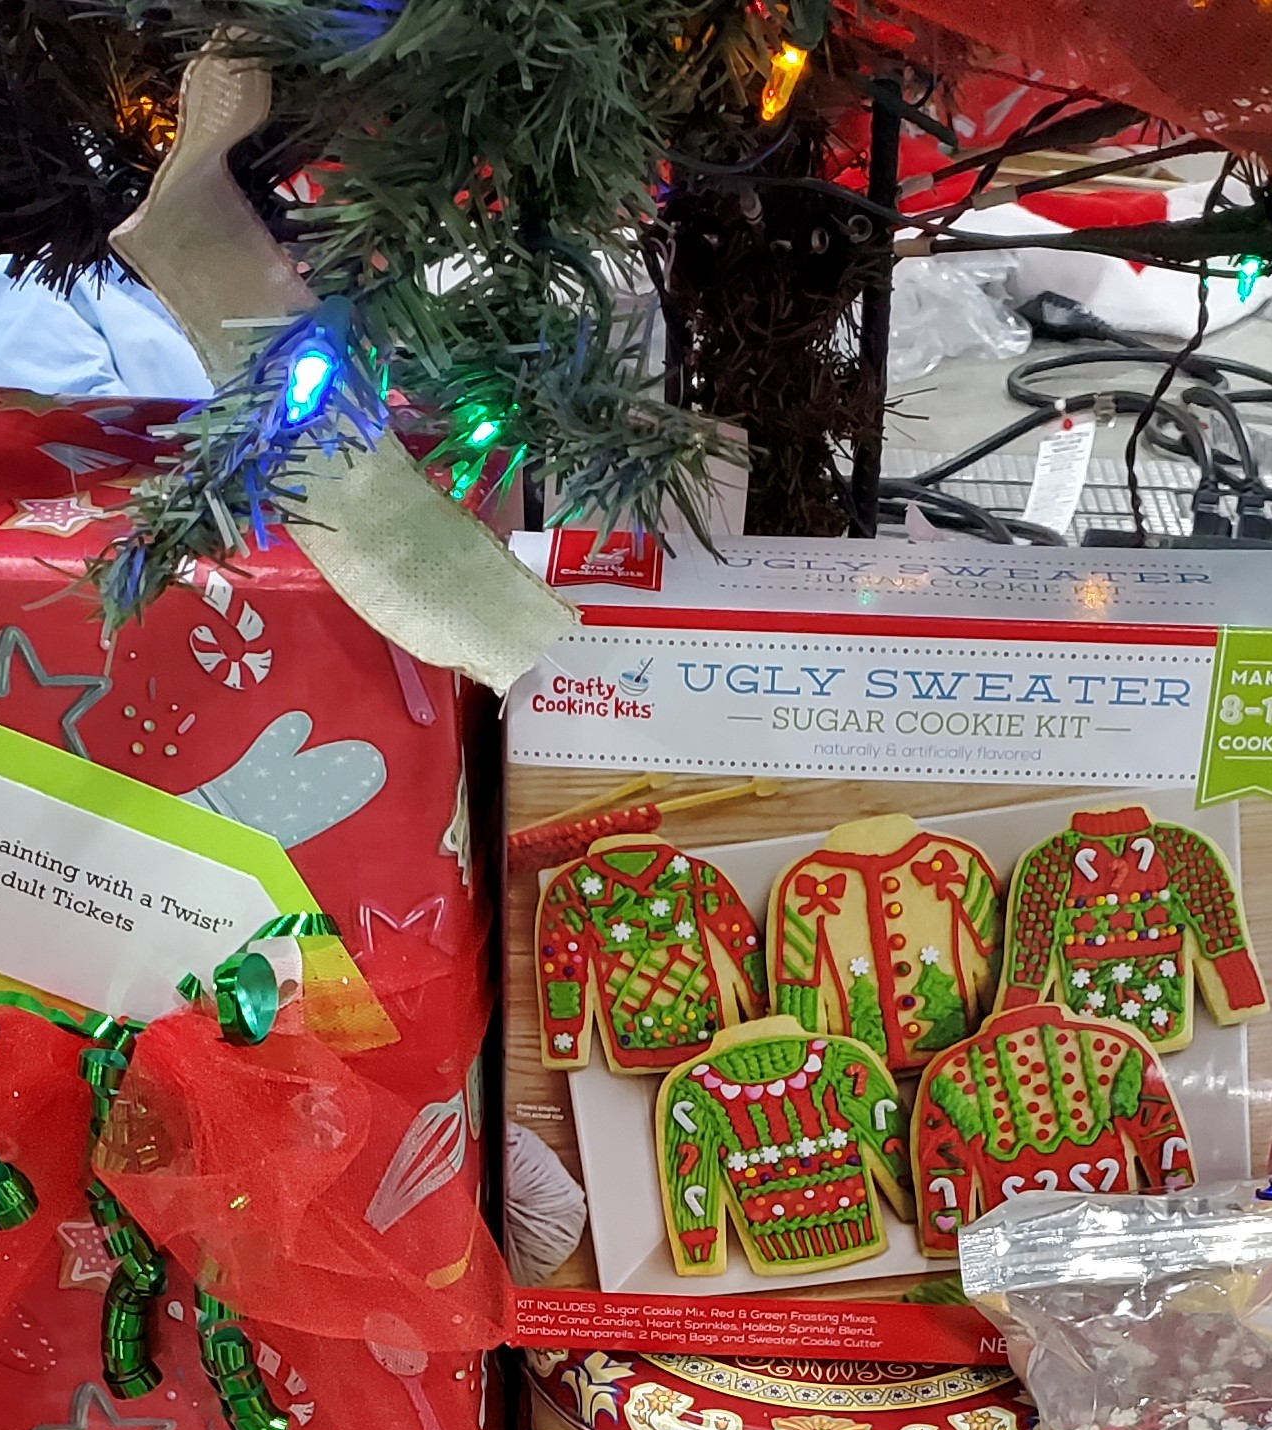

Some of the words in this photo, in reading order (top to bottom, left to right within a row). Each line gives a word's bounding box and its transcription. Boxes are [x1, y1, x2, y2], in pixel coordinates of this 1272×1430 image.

[722, 556, 878, 573] UGLY
[898, 563, 1212, 585] SWEATER
[804, 572, 926, 588] SUGAR
[930, 577, 1062, 595] COOKIE
[1072, 584, 1127, 598] KT
[552, 675, 616, 701] Crafty
[677, 661, 846, 697] UGLY
[865, 668, 1191, 707] SWEATER
[531, 694, 609, 718] Cooking
[614, 697, 652, 719] Kits
[772, 705, 885, 734] SUGAR
[895, 710, 1026, 738] COOKIE
[1034, 714, 1091, 739] KIT
[813, 742, 882, 759] naturally
[885, 743, 898, 757] &
[901, 742, 974, 762] artificially
[976, 746, 1042, 761] flavored
[86, 868, 134, 903] with
[139, 894, 153, 910] a
[53, 885, 136, 934] Tickets
[517, 1299, 535, 1310] KIT
[537, 1301, 597, 1313] INCLUDES
[603, 1303, 640, 1317] Sugar
[642, 1305, 683, 1317] Cookie
[710, 1308, 735, 1319] Red
[738, 1310, 747, 1319] &
[750, 1310, 788, 1321] Green
[790, 1311, 839, 1325] Frosting
[517, 1312, 555, 1326] Candy
[558, 1314, 590, 1325] Cane
[646, 1318, 681, 1329] Heart
[742, 1322, 785, 1335] Holiday
[788, 1324, 836, 1336] Sprinkle
[517, 1325, 568, 1336] Rainbow
[638, 1330, 649, 1339] 2
[650, 1332, 687, 1344] Piping
[689, 1333, 719, 1345] Bags
[721, 1334, 745, 1344] and
[748, 1335, 798, 1346] Sweater
[800, 1336, 841, 1347] Cookie
[844, 1338, 883, 1349] Cutter
[979, 1336, 1008, 1354] NE
